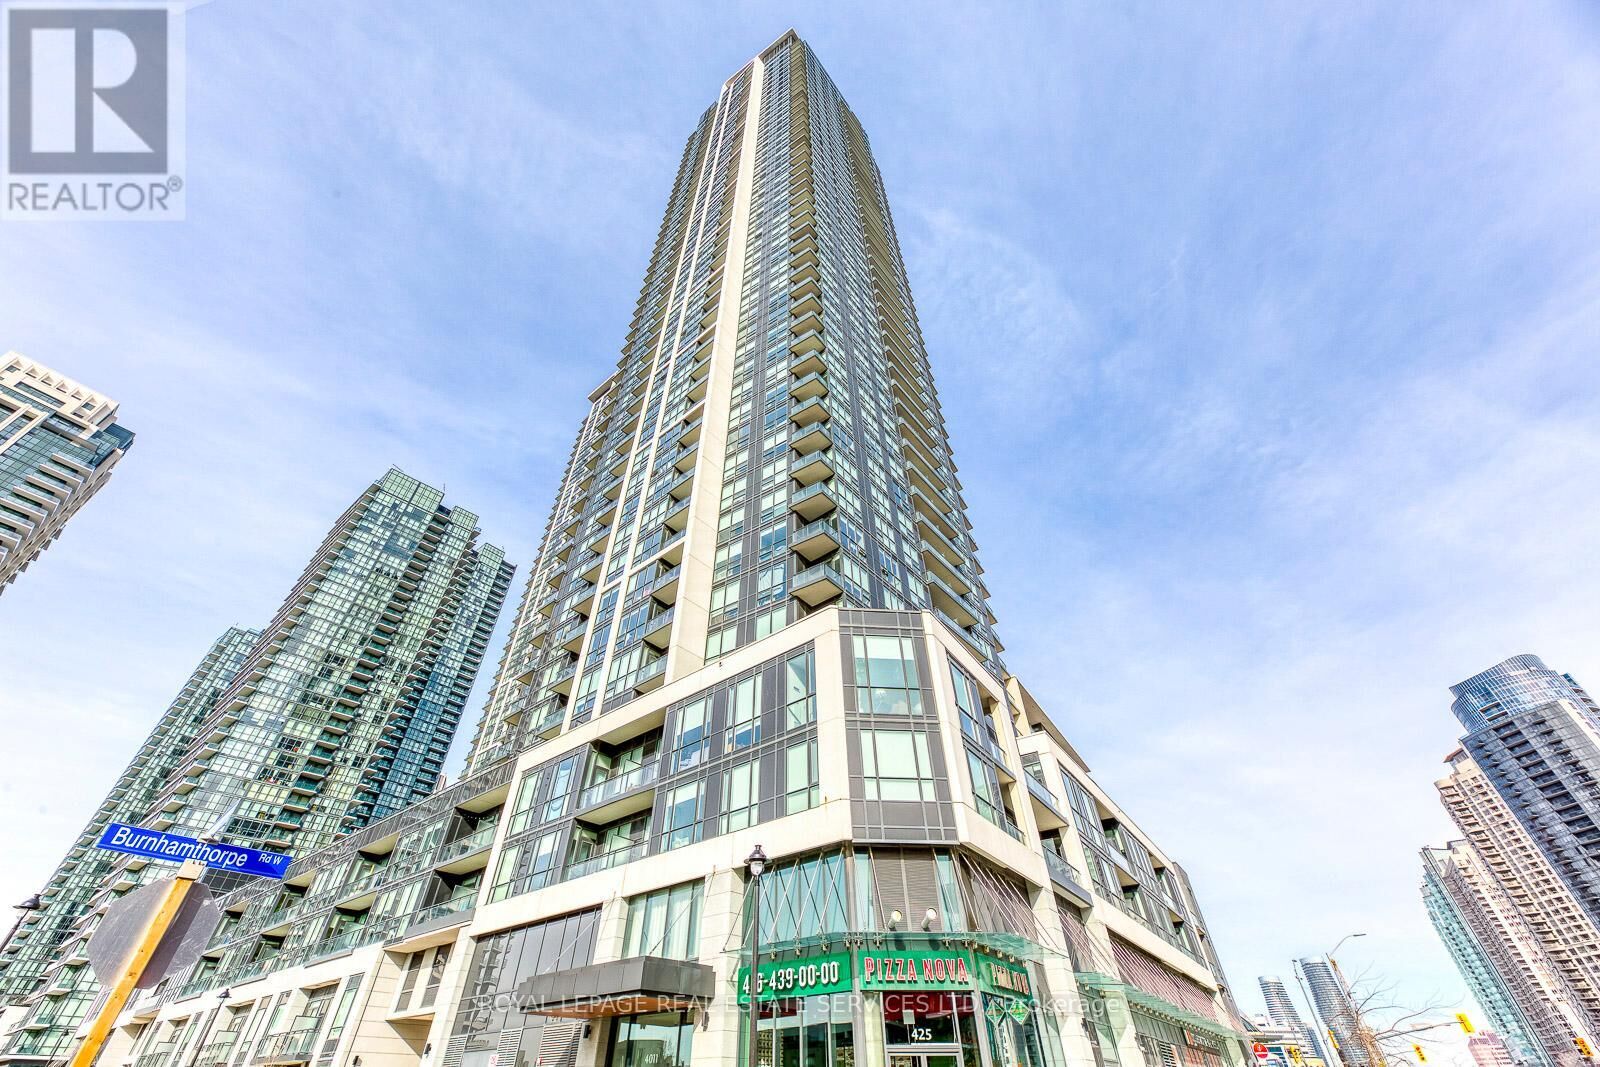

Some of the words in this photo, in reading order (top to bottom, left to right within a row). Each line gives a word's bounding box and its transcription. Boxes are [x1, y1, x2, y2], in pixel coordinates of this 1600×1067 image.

[111, 826, 248, 868] Burnhamthorpe
[258, 853, 273, 864] Rd
[273, 855, 284, 865] W
[743, 961, 839, 994] 46-439-00-00
[864, 957, 917, 984] PIZZA
[922, 958, 969, 984] NOVA
[911, 1028, 932, 1041] 425
